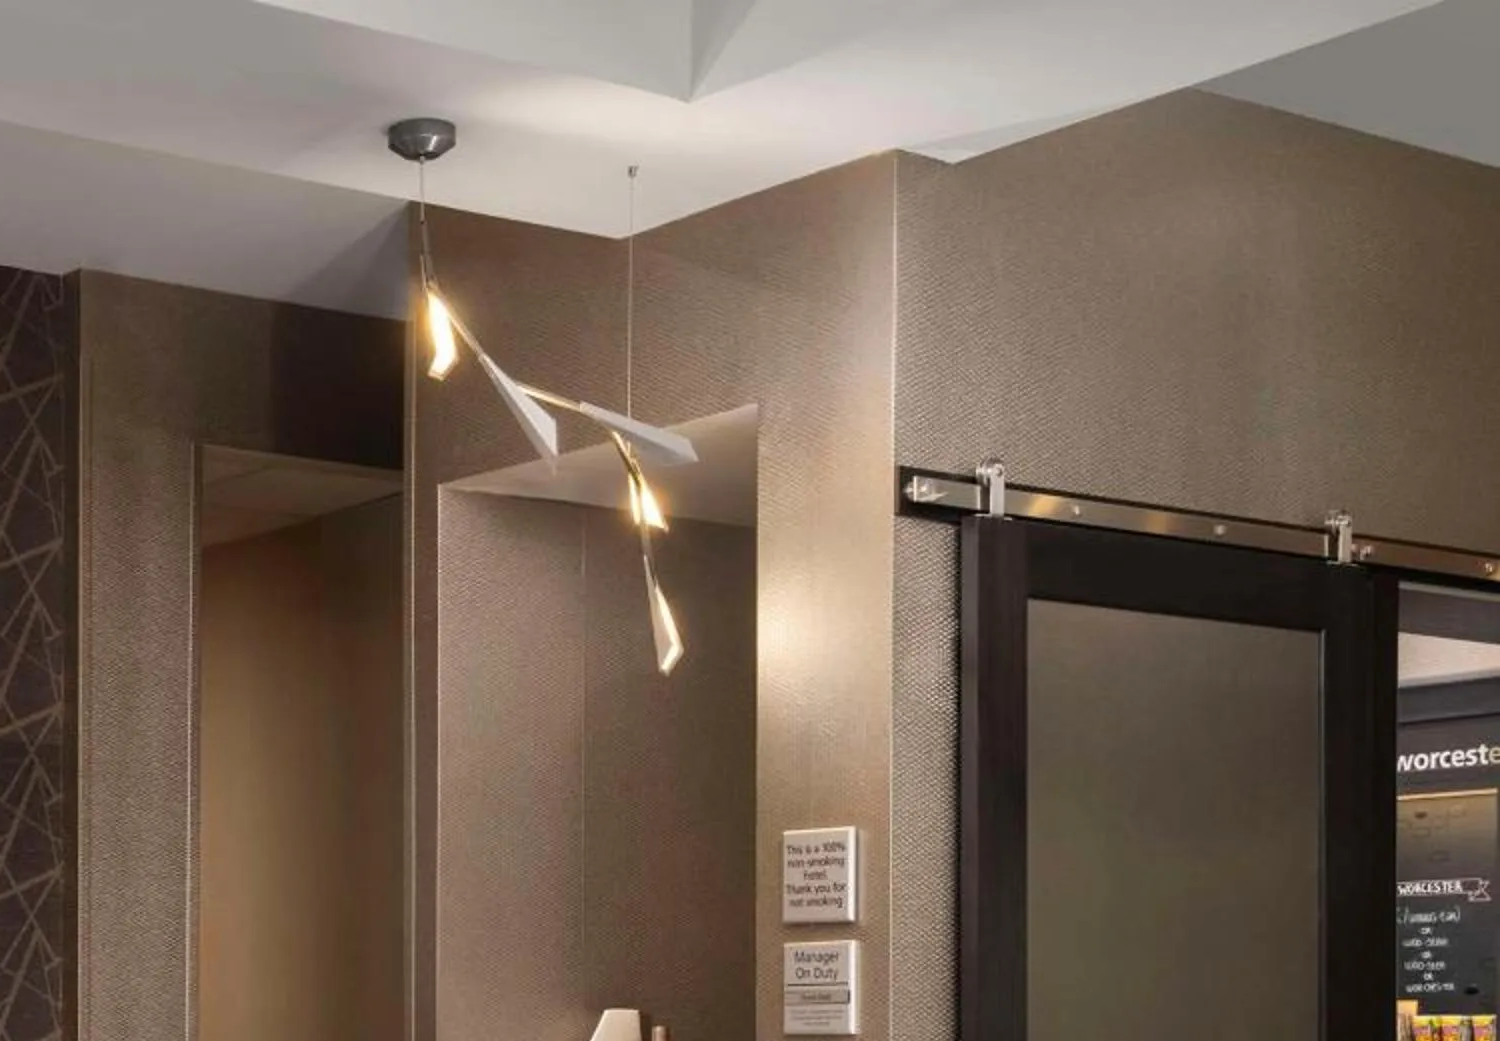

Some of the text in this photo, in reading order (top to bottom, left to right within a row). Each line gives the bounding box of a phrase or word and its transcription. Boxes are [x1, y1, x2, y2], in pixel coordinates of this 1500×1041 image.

[787, 845, 803, 854] This
[786, 881, 846, 895] Thank you for
[794, 951, 839, 966] Manager
[795, 966, 838, 981] On Duty
